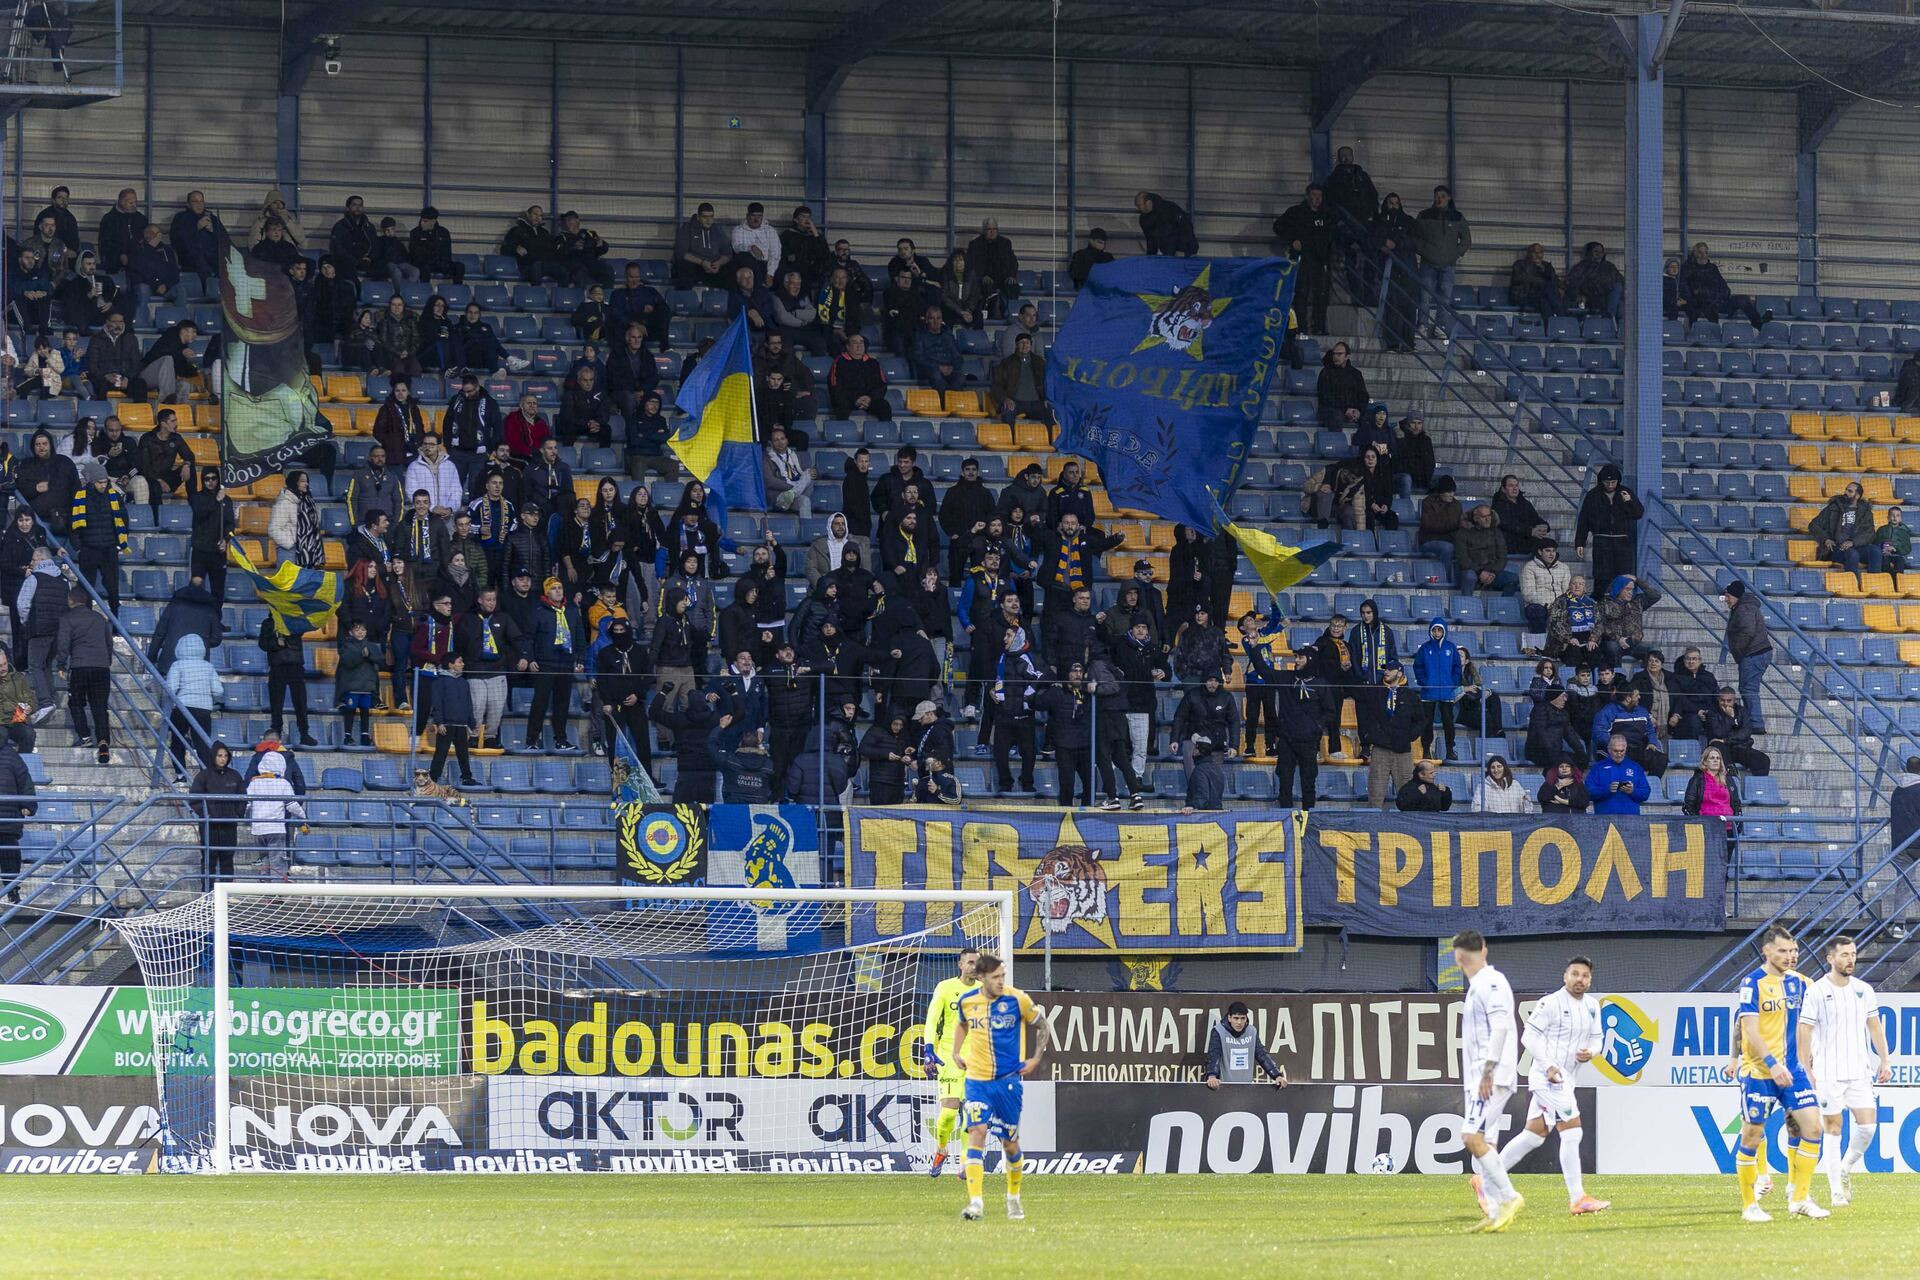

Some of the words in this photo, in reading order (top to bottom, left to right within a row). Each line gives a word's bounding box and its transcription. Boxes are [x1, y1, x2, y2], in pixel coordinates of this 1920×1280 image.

[1319, 822, 1705, 908] ΤΡΙΠΟΛΗ
[859, 818, 1287, 938] TIGERS
[116, 1001, 442, 1046] wwwbiogreco.gr
[228, 1052, 321, 1068] ΟΤΟΠΟΥΛΑ
[0, 1104, 177, 1147] OVA
[230, 1105, 463, 1146] NOVA
[5, 1149, 139, 1174] novibet
[297, 1148, 426, 1172] novibet
[453, 1149, 582, 1173] novibet
[611, 1148, 738, 1172] novibet
[769, 1152, 896, 1173] novibet
